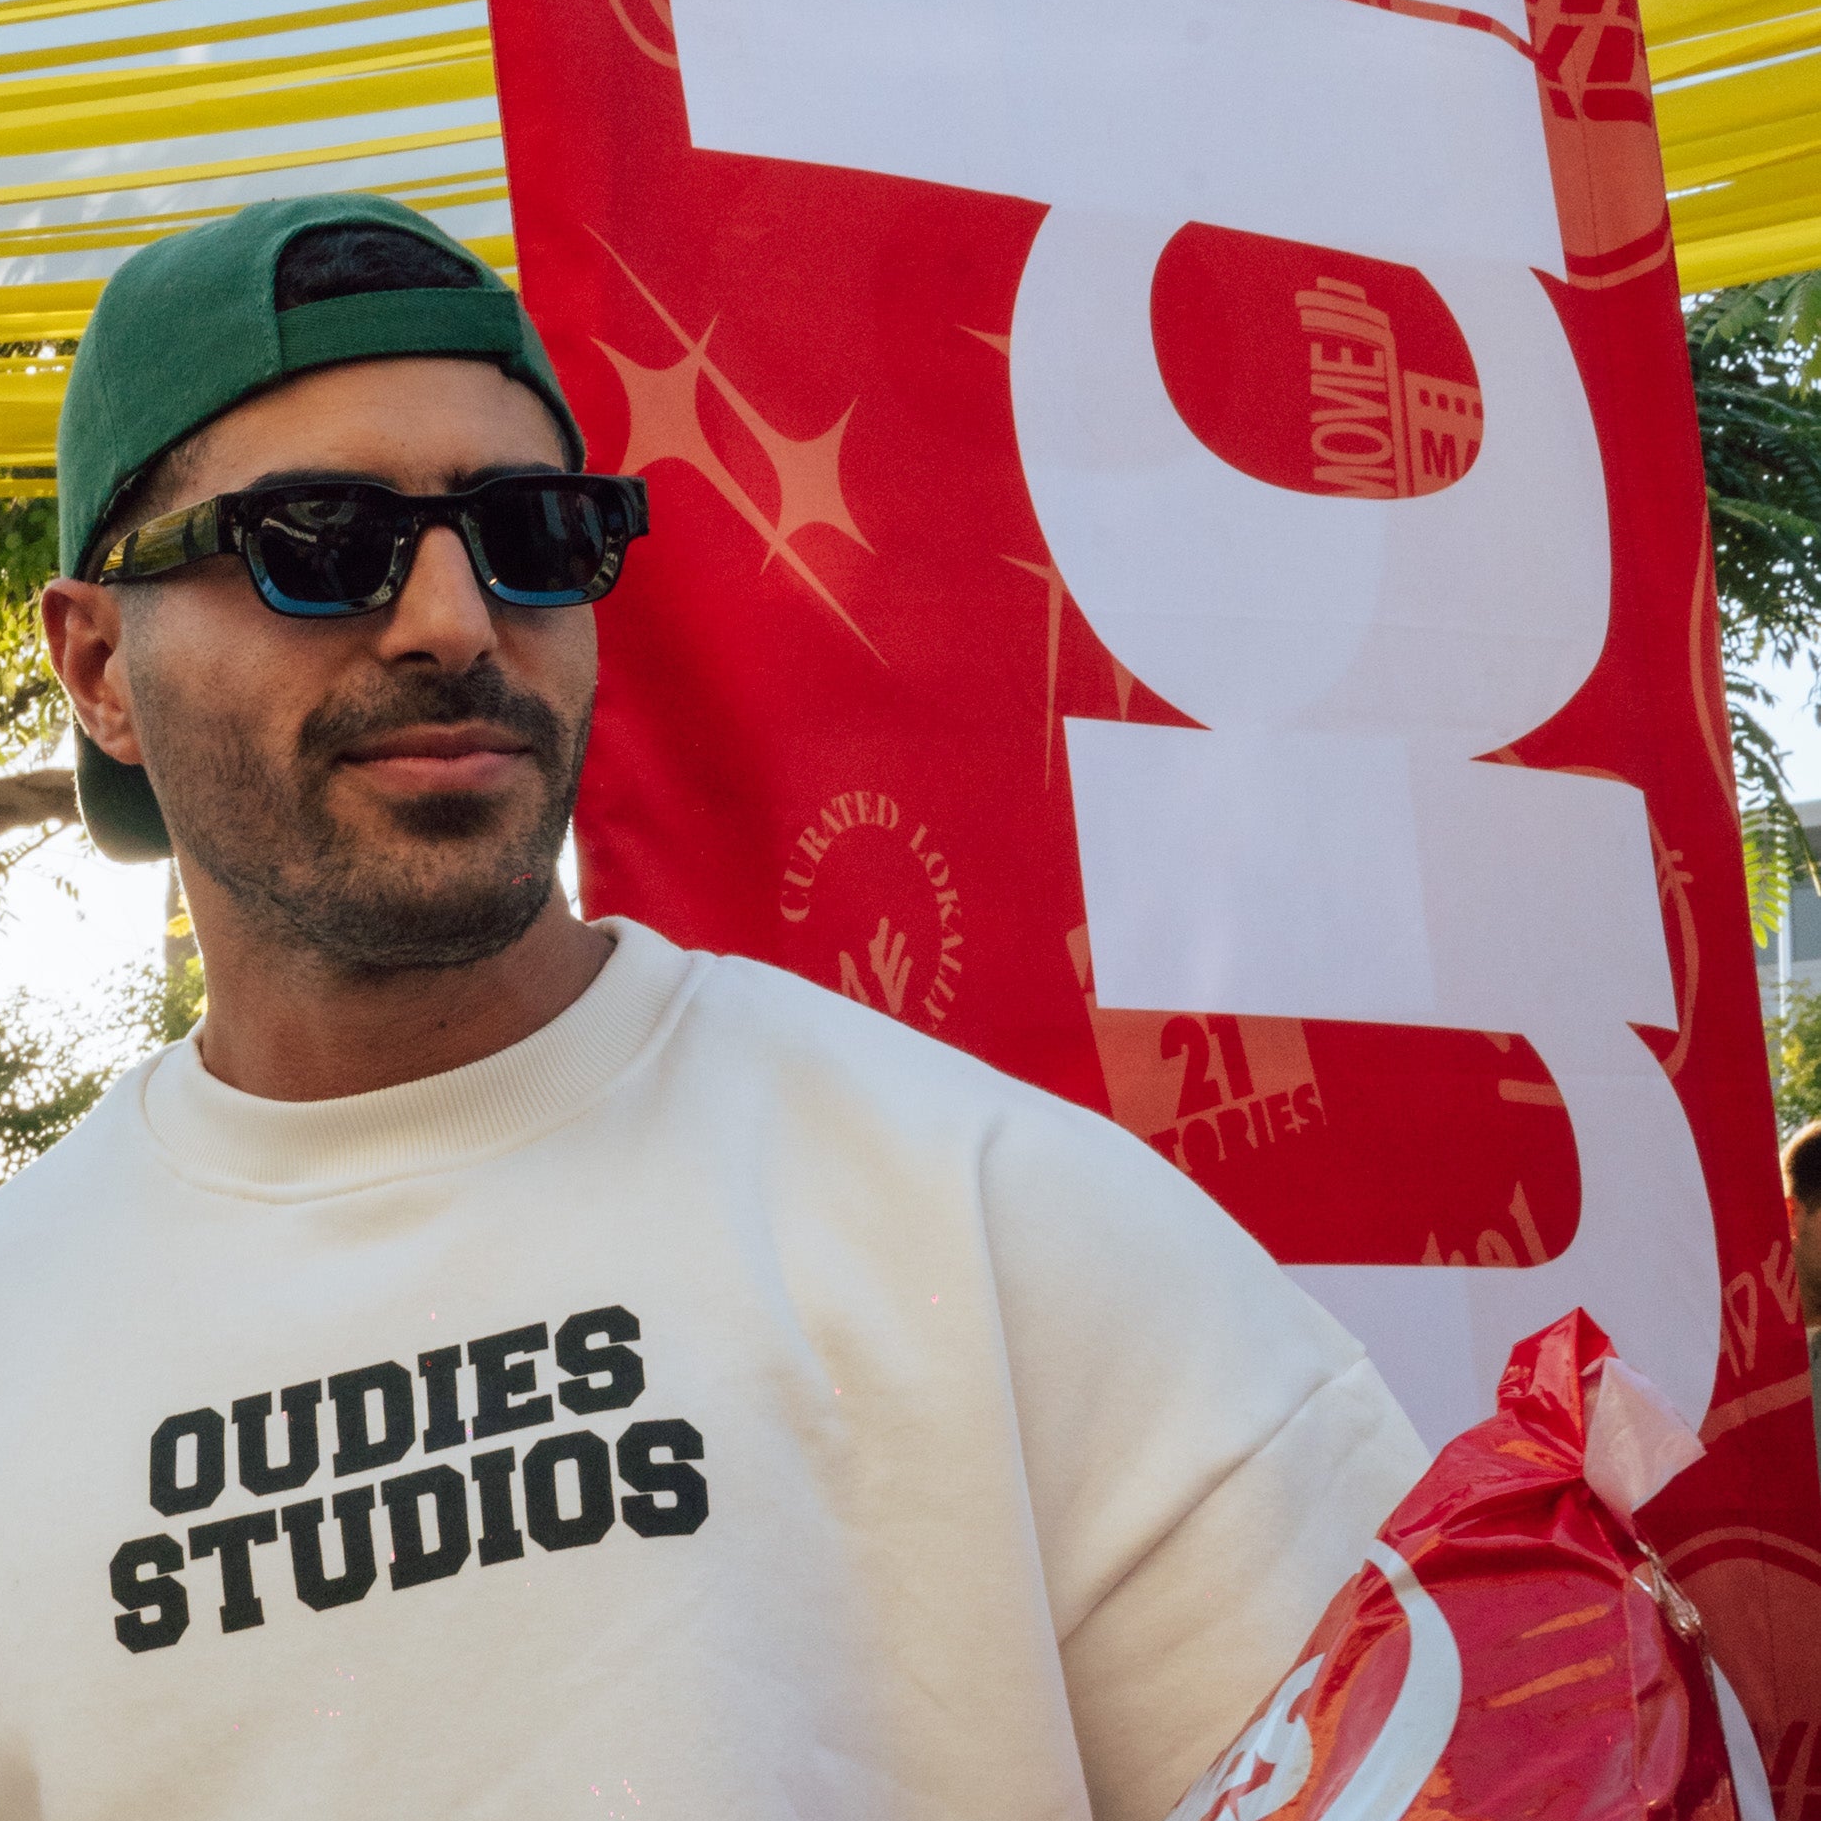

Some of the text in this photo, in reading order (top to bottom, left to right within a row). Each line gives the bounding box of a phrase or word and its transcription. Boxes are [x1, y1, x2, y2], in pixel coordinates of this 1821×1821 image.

[780, 790, 899, 923] CURATED
[1161, 1013, 1255, 1120] 21
[150, 1305, 646, 1517] OUDIES
[109, 1418, 709, 1655] STUDIOS
